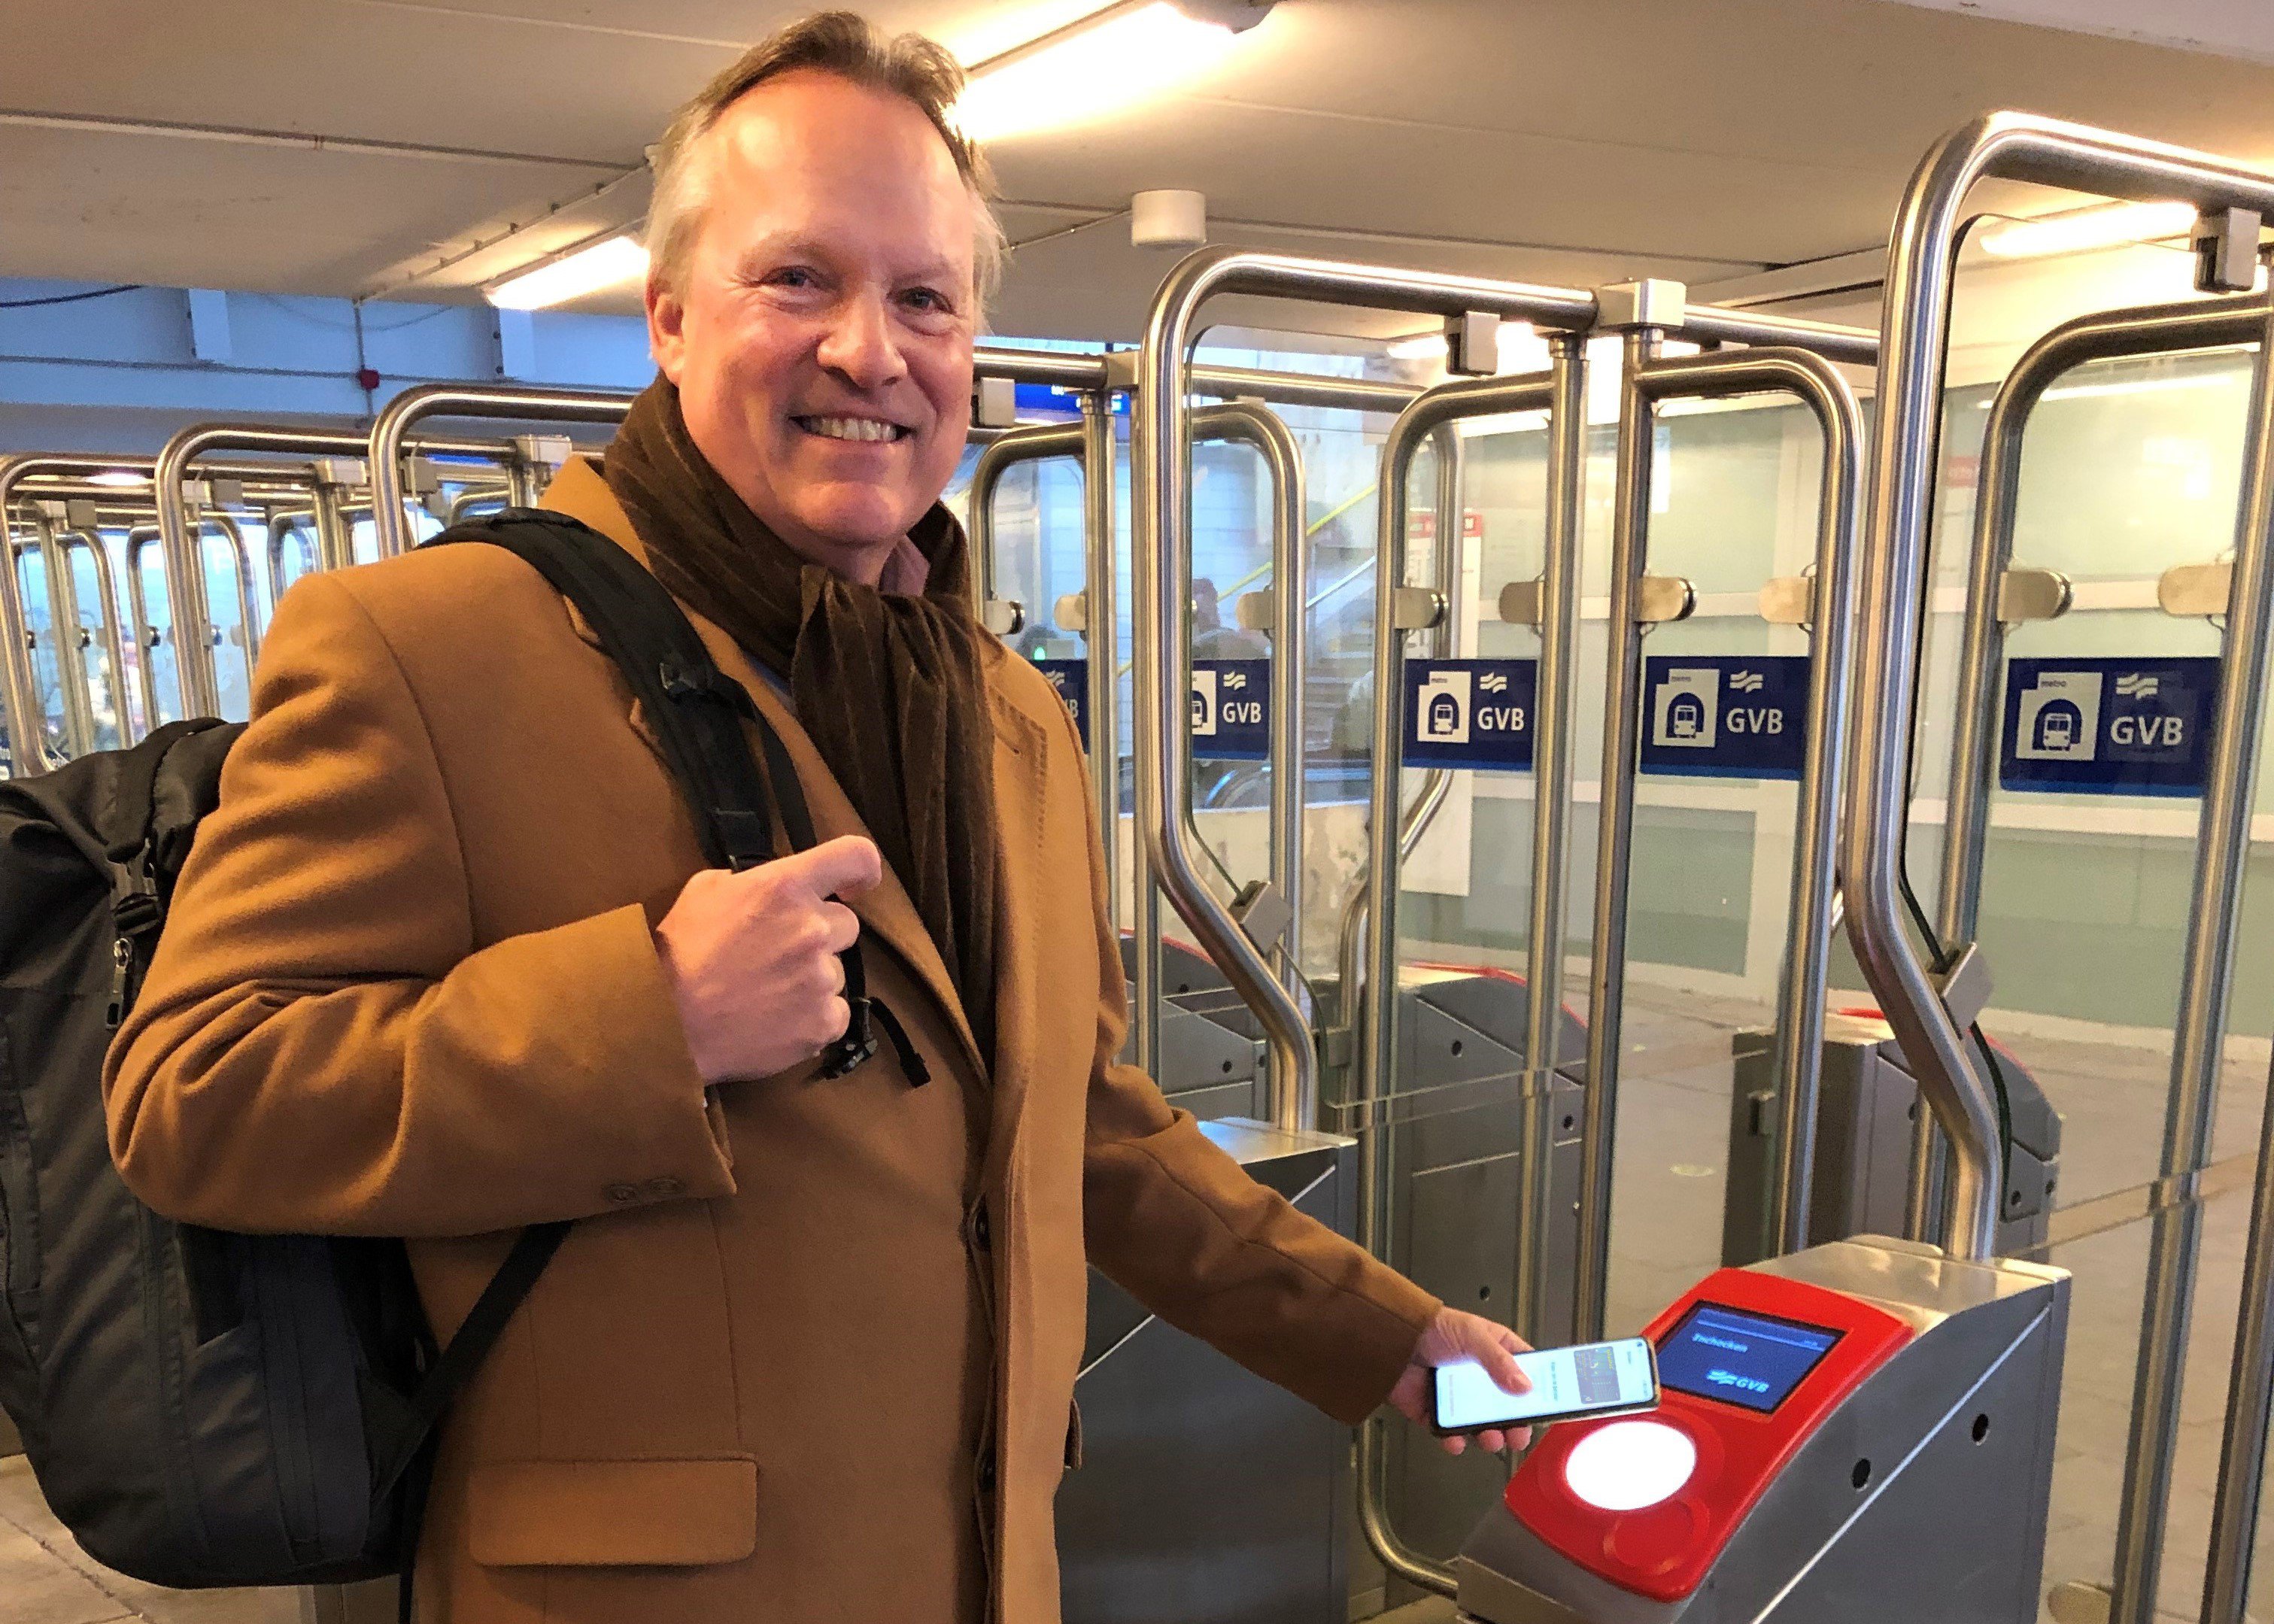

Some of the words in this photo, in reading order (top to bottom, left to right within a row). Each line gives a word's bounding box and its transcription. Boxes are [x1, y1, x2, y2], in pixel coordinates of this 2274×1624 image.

[1222, 702, 1261, 724] GVB
[1477, 706, 1525, 731] GVB
[1726, 707, 1784, 734] GVB
[2110, 716, 2183, 745] GVB
[1735, 1377, 1769, 1393] GVB
